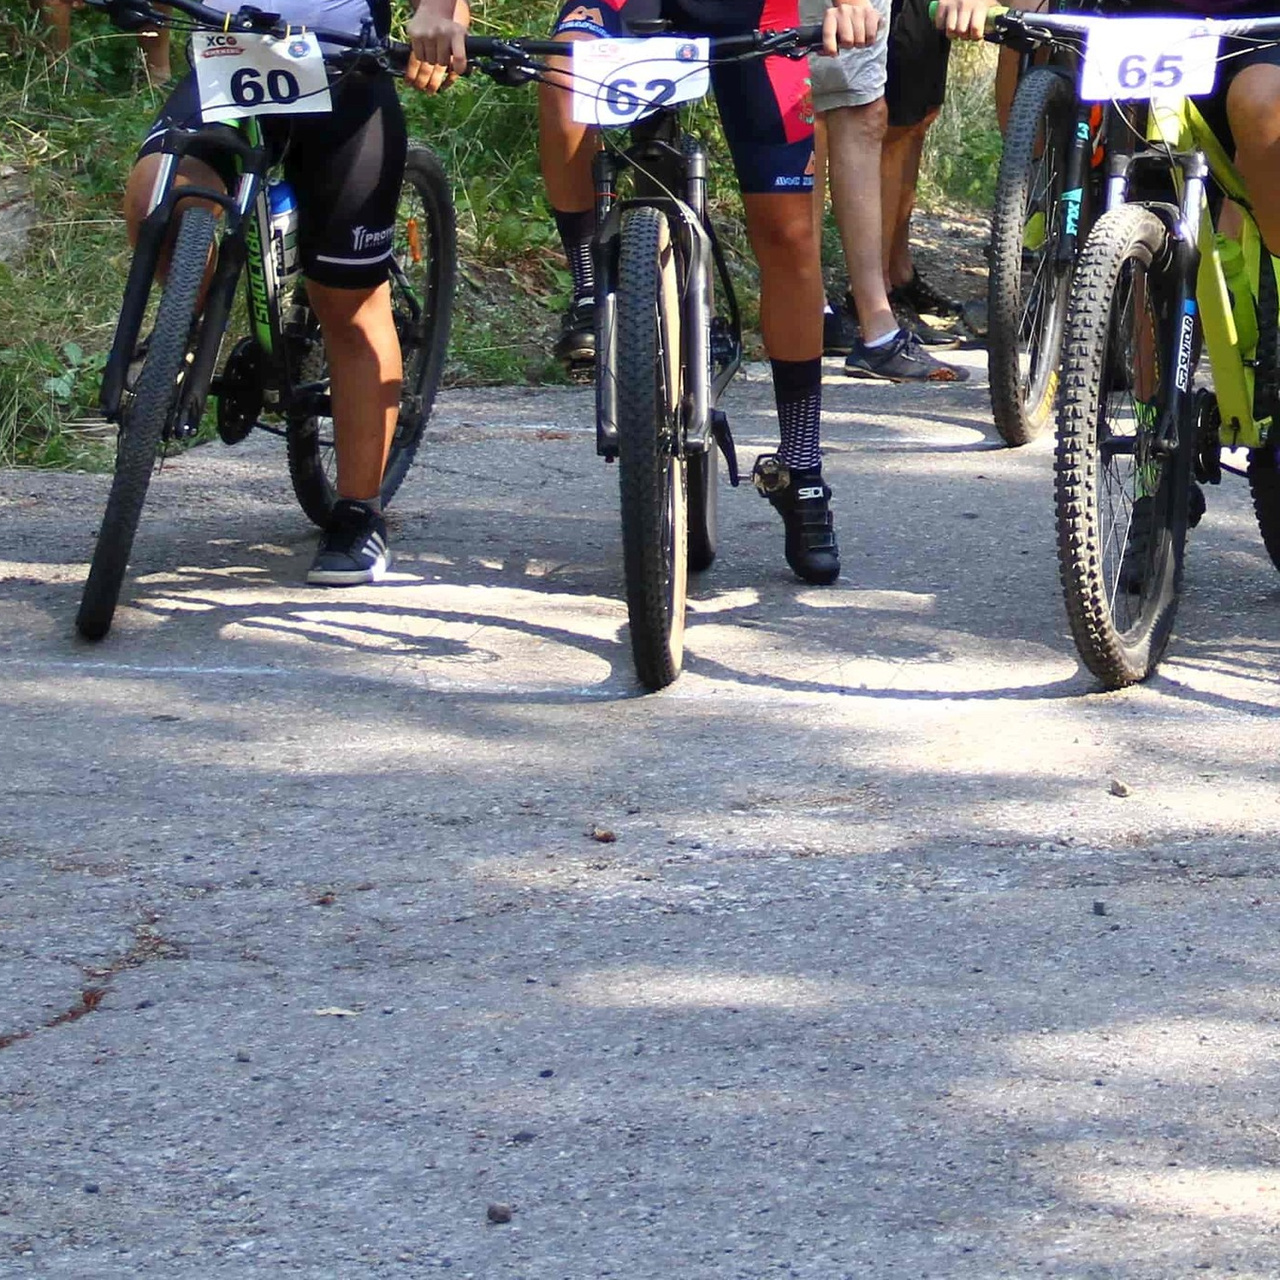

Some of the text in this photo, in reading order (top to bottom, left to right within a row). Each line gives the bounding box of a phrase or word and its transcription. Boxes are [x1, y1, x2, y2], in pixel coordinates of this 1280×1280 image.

[230, 68, 301, 107] 60
[1117, 55, 1184, 89] 65
[606, 78, 677, 116] 62
